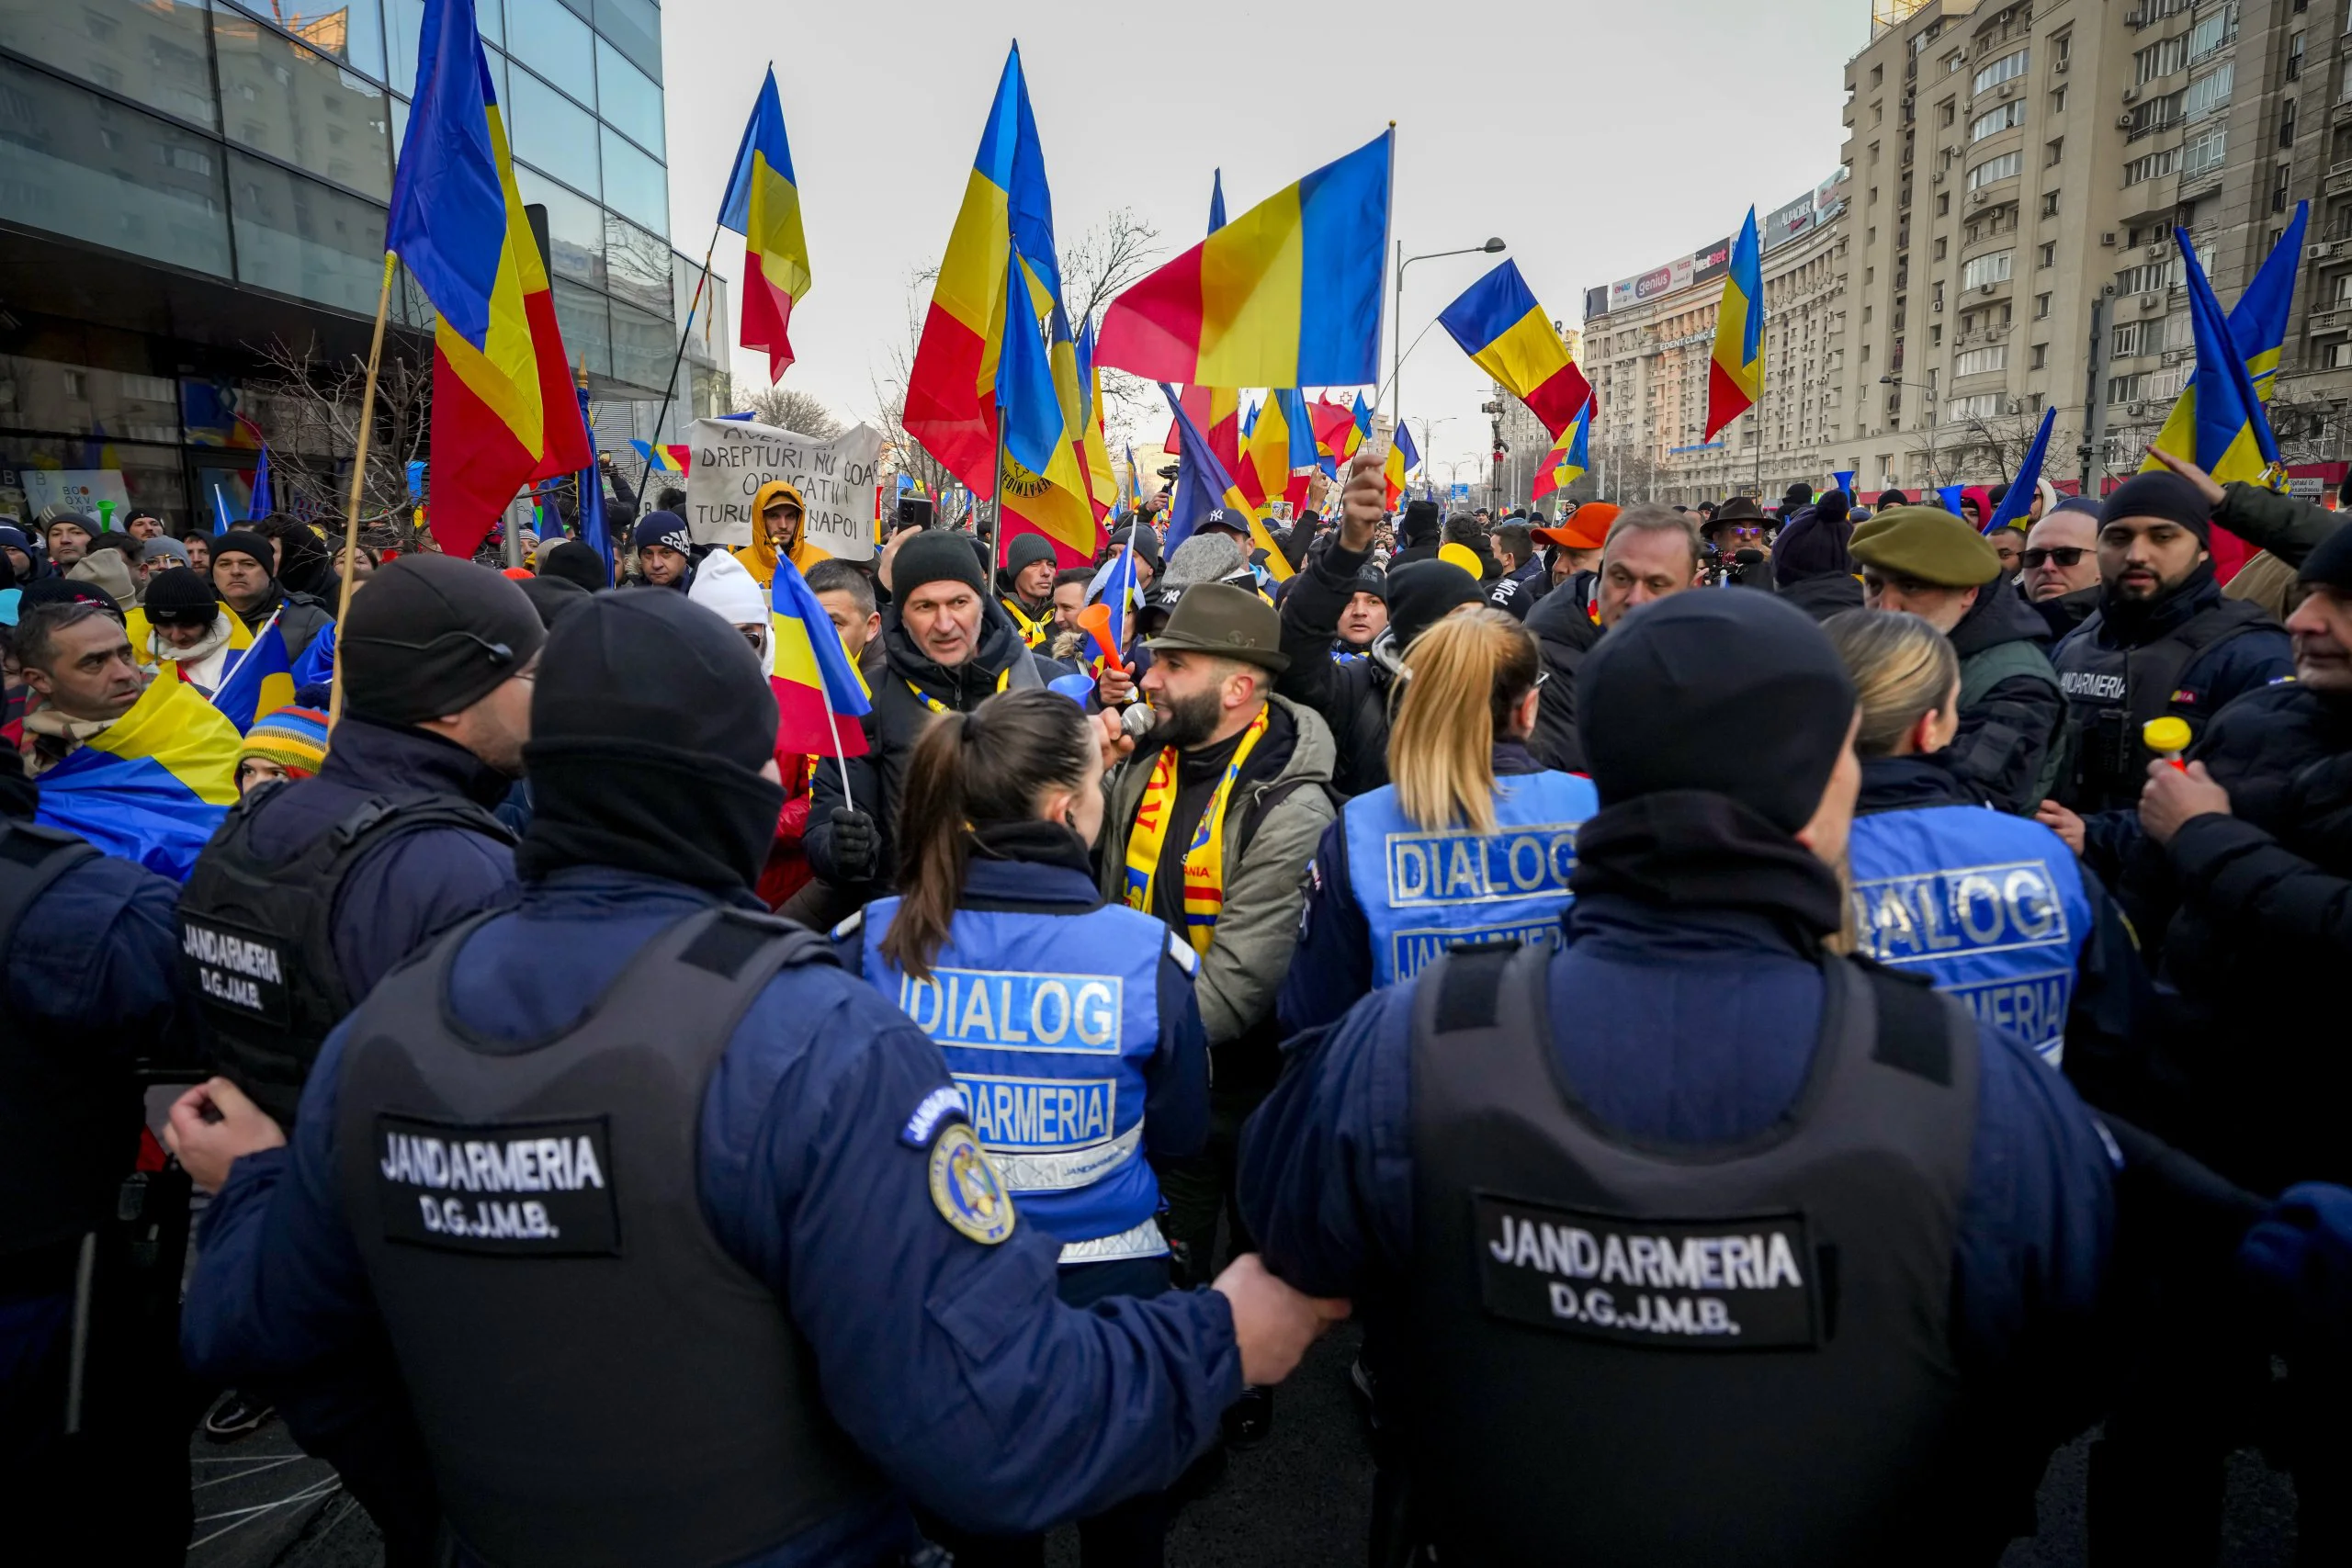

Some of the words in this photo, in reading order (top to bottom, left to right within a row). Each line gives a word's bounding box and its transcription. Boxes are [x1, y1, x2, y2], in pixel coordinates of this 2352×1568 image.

[1638, 273, 1668, 296] genius
[1685, 332, 1709, 344] CLINIC
[723, 427, 794, 445] AVE
[814, 452, 837, 476] NU
[695, 504, 752, 525] TURU
[804, 504, 857, 540] NAPOI
[1396, 833, 1580, 899] DIALOG
[183, 922, 283, 985] JANDARMERIA
[910, 975, 1114, 1046] DIALOG
[379, 1132, 605, 1192] JANDARMERIA
[1488, 1214, 1803, 1291] JANDARMERIA
[1548, 1281, 1742, 1336] D.G.J.M.B.
